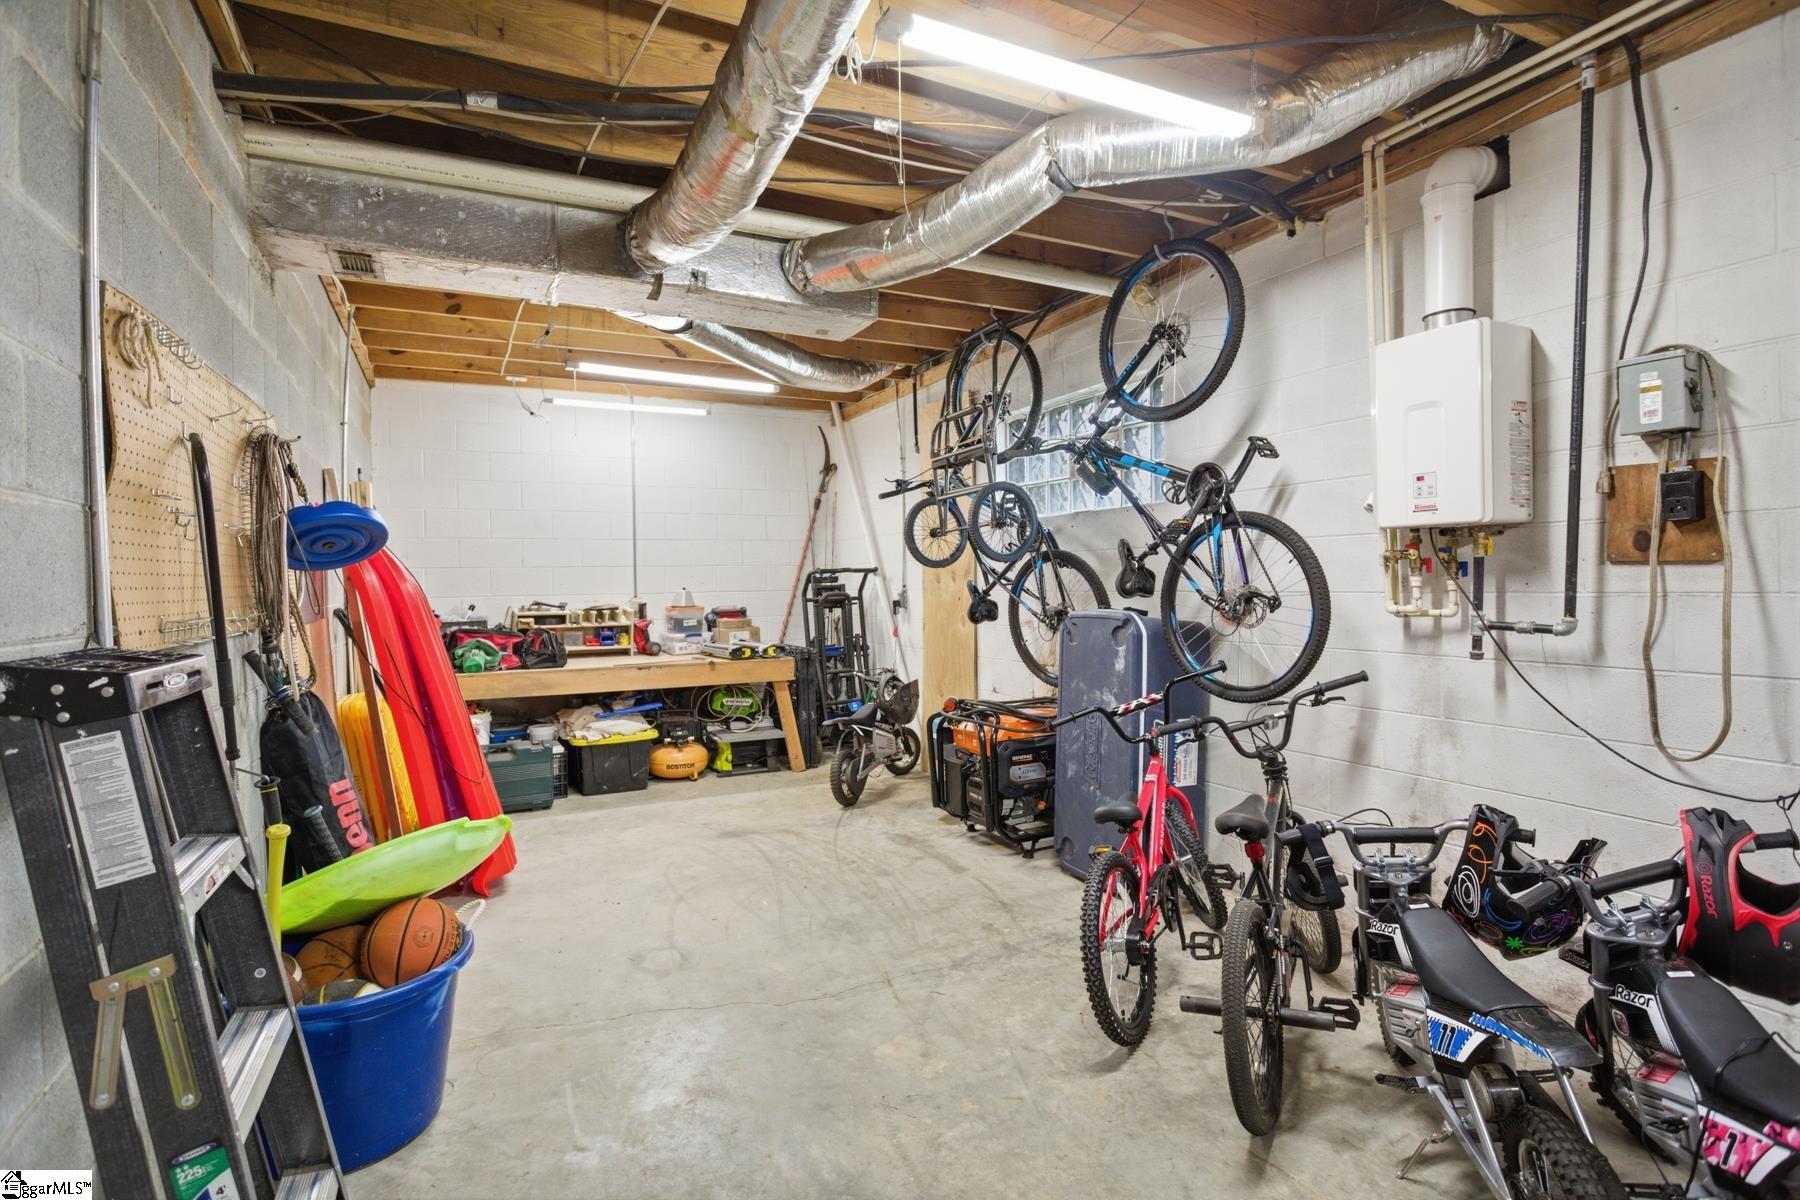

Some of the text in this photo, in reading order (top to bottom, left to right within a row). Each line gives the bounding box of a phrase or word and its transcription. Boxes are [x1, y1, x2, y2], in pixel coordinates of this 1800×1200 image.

[1700, 874, 1718, 919] Razor
[1370, 919, 1399, 936] Razor
[1615, 984, 1654, 1008] Razor
[1436, 1022, 1457, 1057] 11
